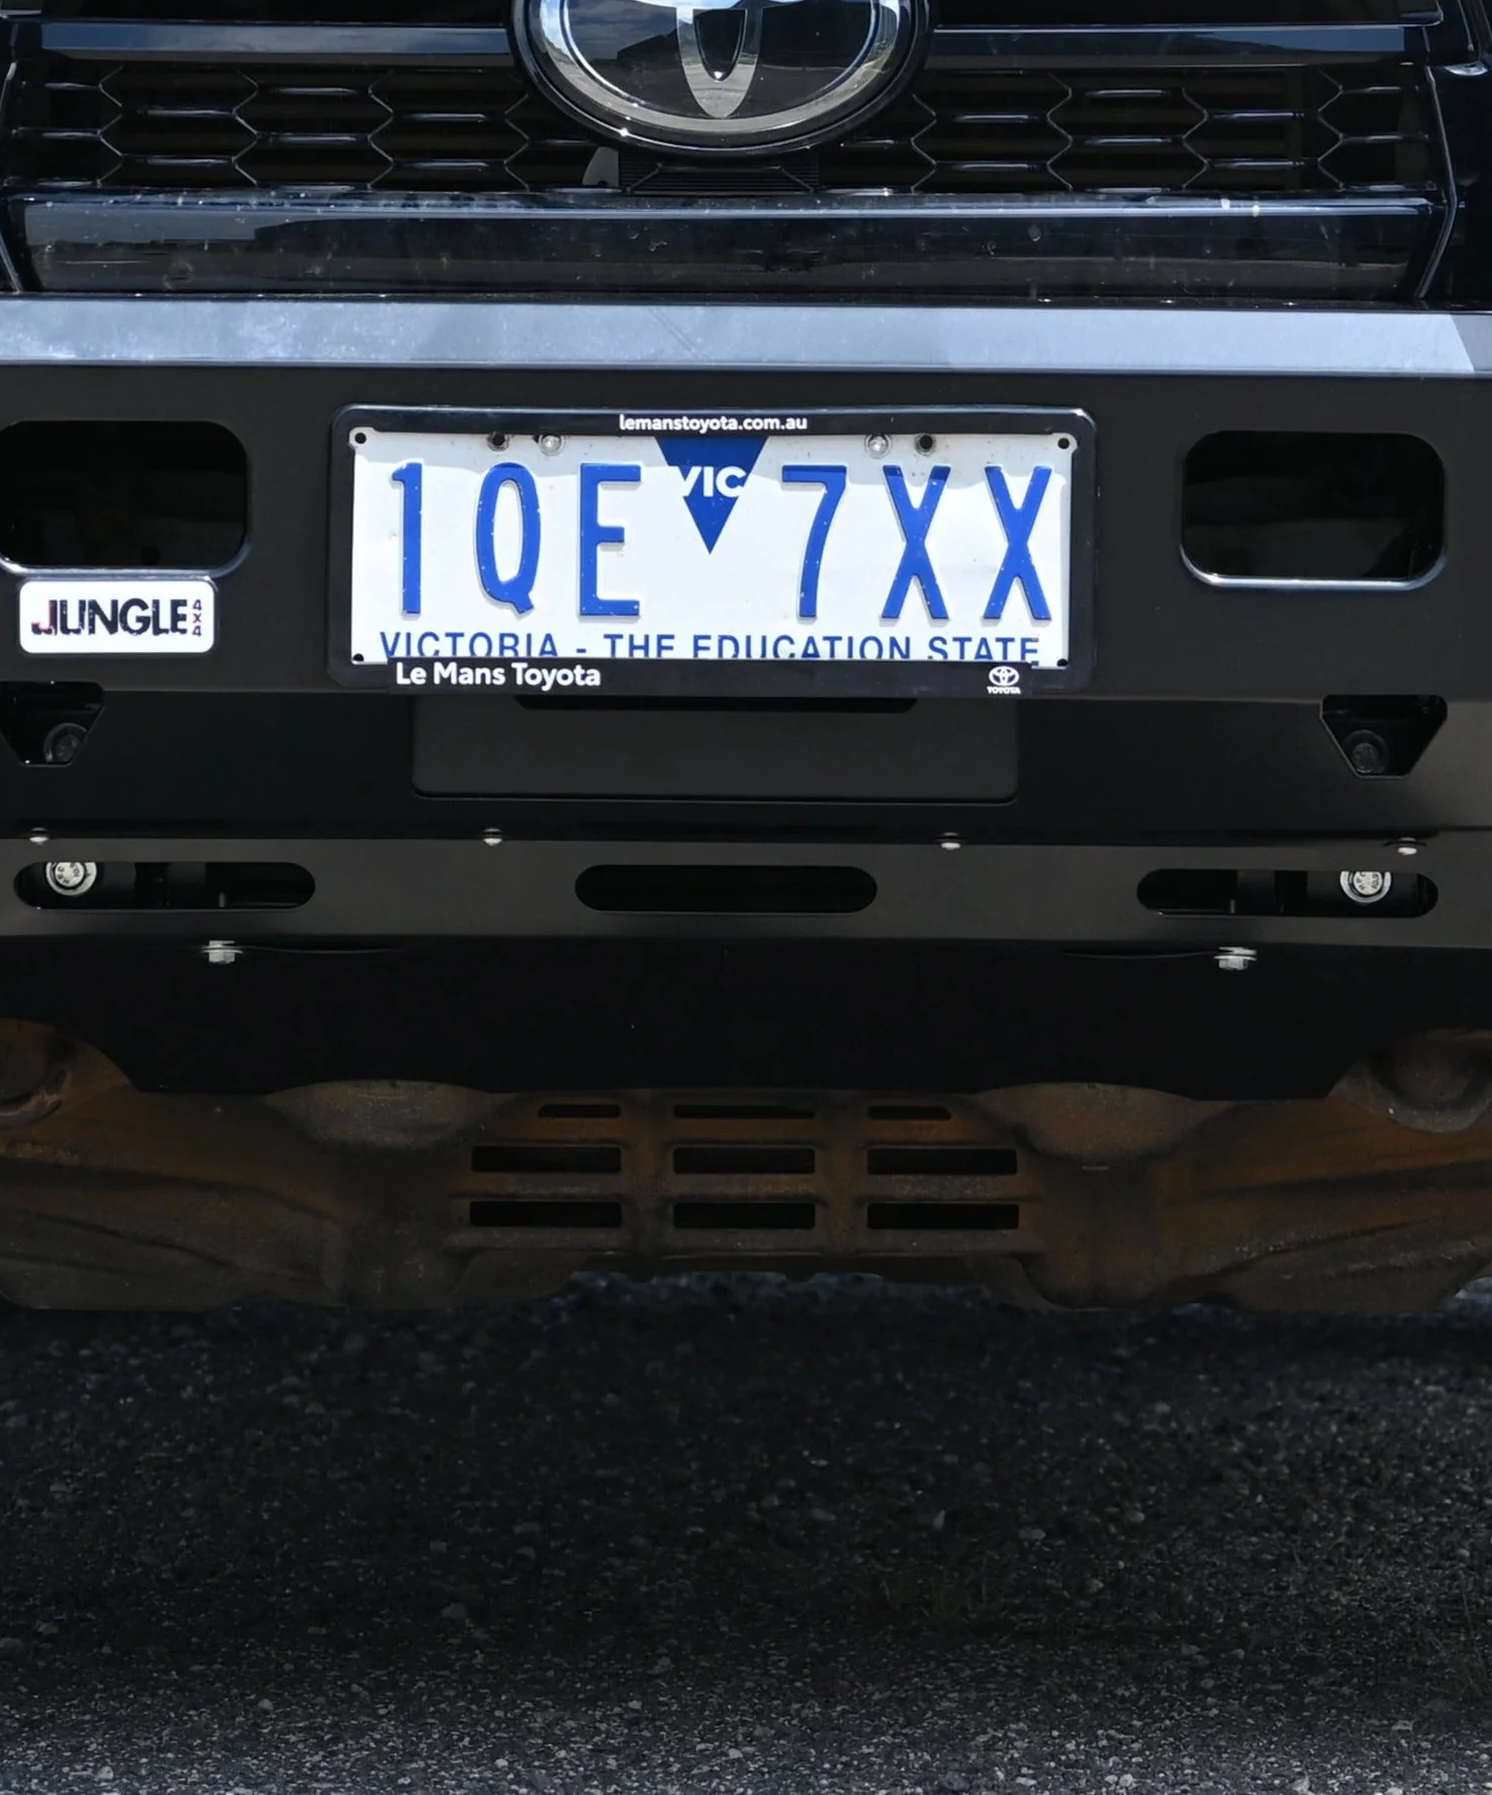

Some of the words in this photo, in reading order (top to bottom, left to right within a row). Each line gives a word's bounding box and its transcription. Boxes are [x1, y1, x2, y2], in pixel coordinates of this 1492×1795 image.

[619, 414, 808, 435] lemanstoyota.com.au
[673, 465, 747, 498] VIC
[390, 461, 643, 617] 1QE
[781, 462, 1053, 621] 7XX
[31, 598, 188, 636] JUNGLE
[379, 631, 559, 659] VICTORIA
[603, 633, 676, 660] THE
[693, 634, 911, 661] EDUCATION
[927, 636, 1040, 666] STATE
[395, 661, 427, 686] Le
[432, 661, 506, 686] Mans
[511, 662, 601, 691] Toyota
[986, 685, 1021, 695] TOYOTA
